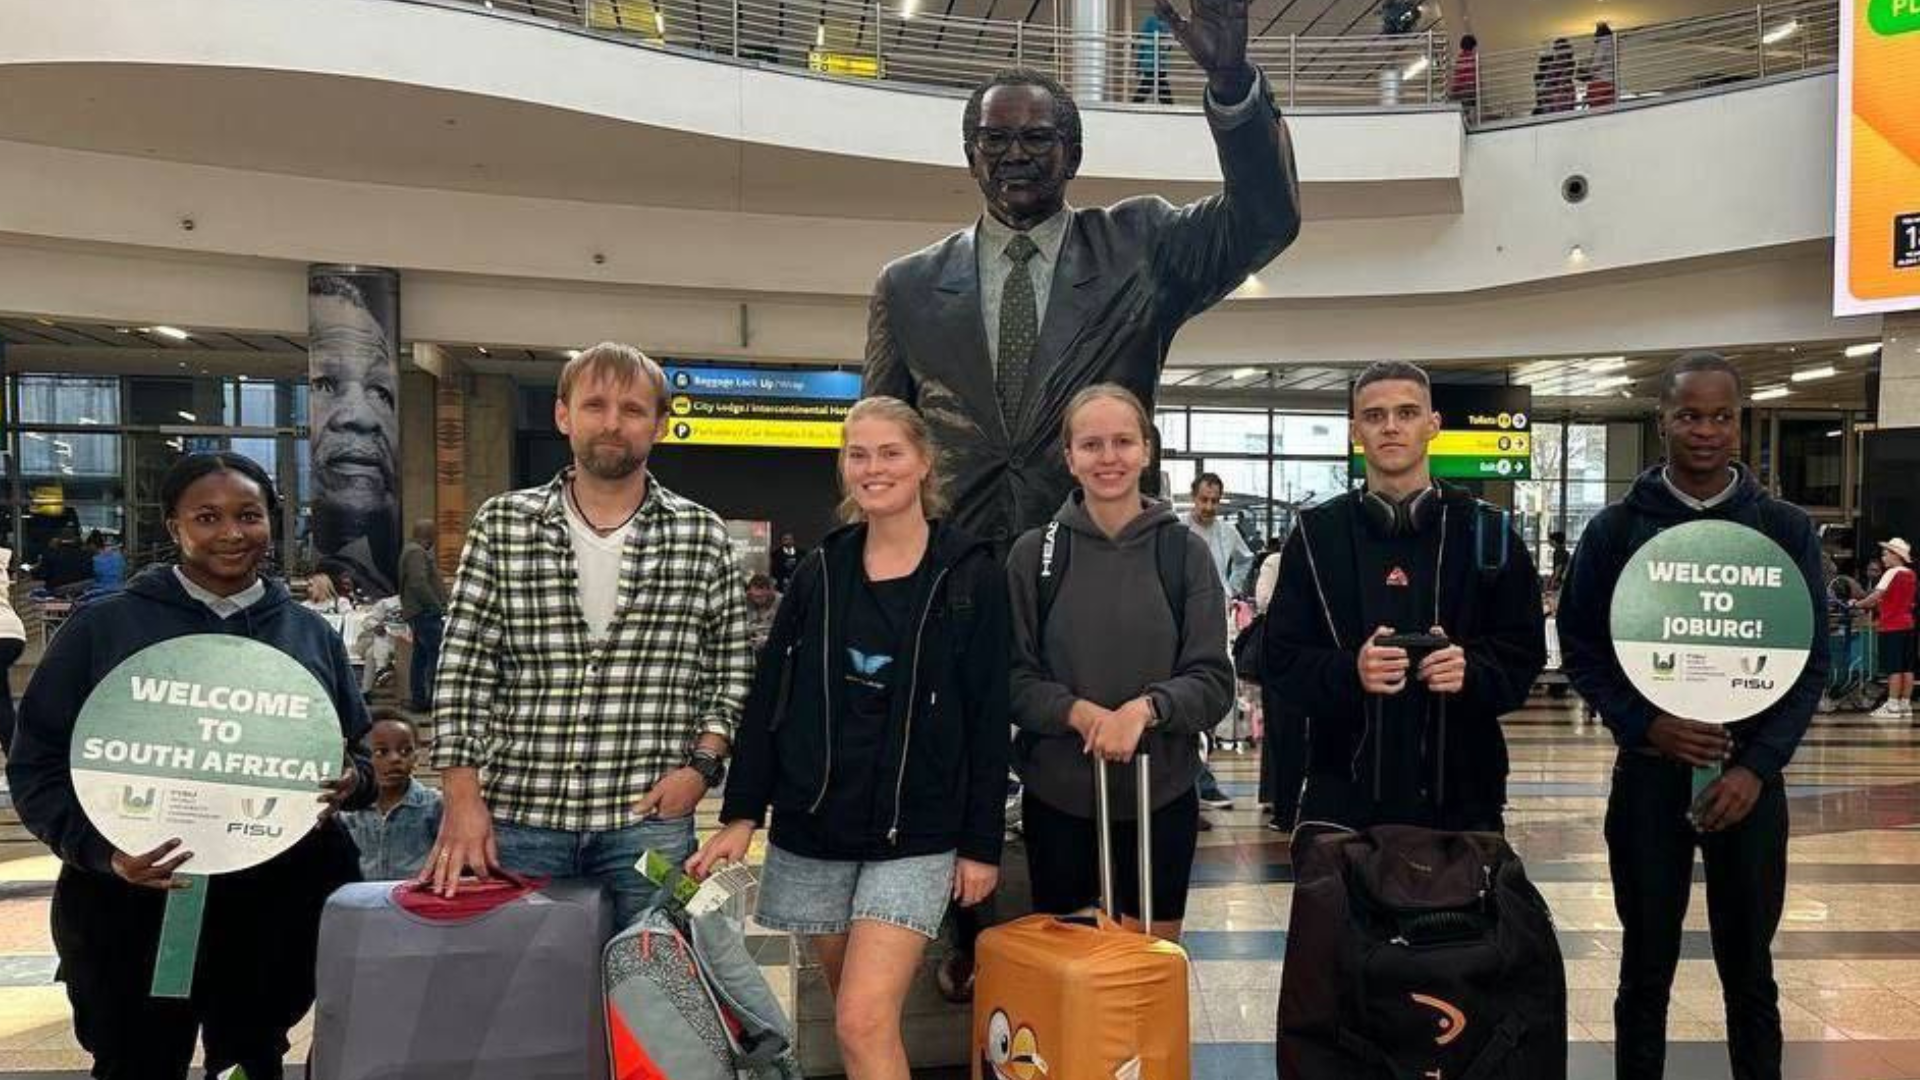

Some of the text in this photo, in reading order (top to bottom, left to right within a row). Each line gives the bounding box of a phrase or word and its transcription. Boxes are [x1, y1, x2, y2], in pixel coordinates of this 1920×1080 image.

[760, 379, 774, 391] Up
[693, 401, 715, 414] City
[716, 402, 745, 414] Lodge
[1041, 520, 1060, 577] HEAD
[1648, 561, 1783, 588] WELCOME
[1699, 591, 1734, 612] TO
[1662, 616, 1763, 640] JOBURG!
[1731, 678, 1775, 690] FISU
[130, 675, 310, 719] WELCOME
[197, 716, 242, 743] TO
[82, 737, 331, 782] SOUTH AFRICA!
[226, 822, 283, 838] FISU
